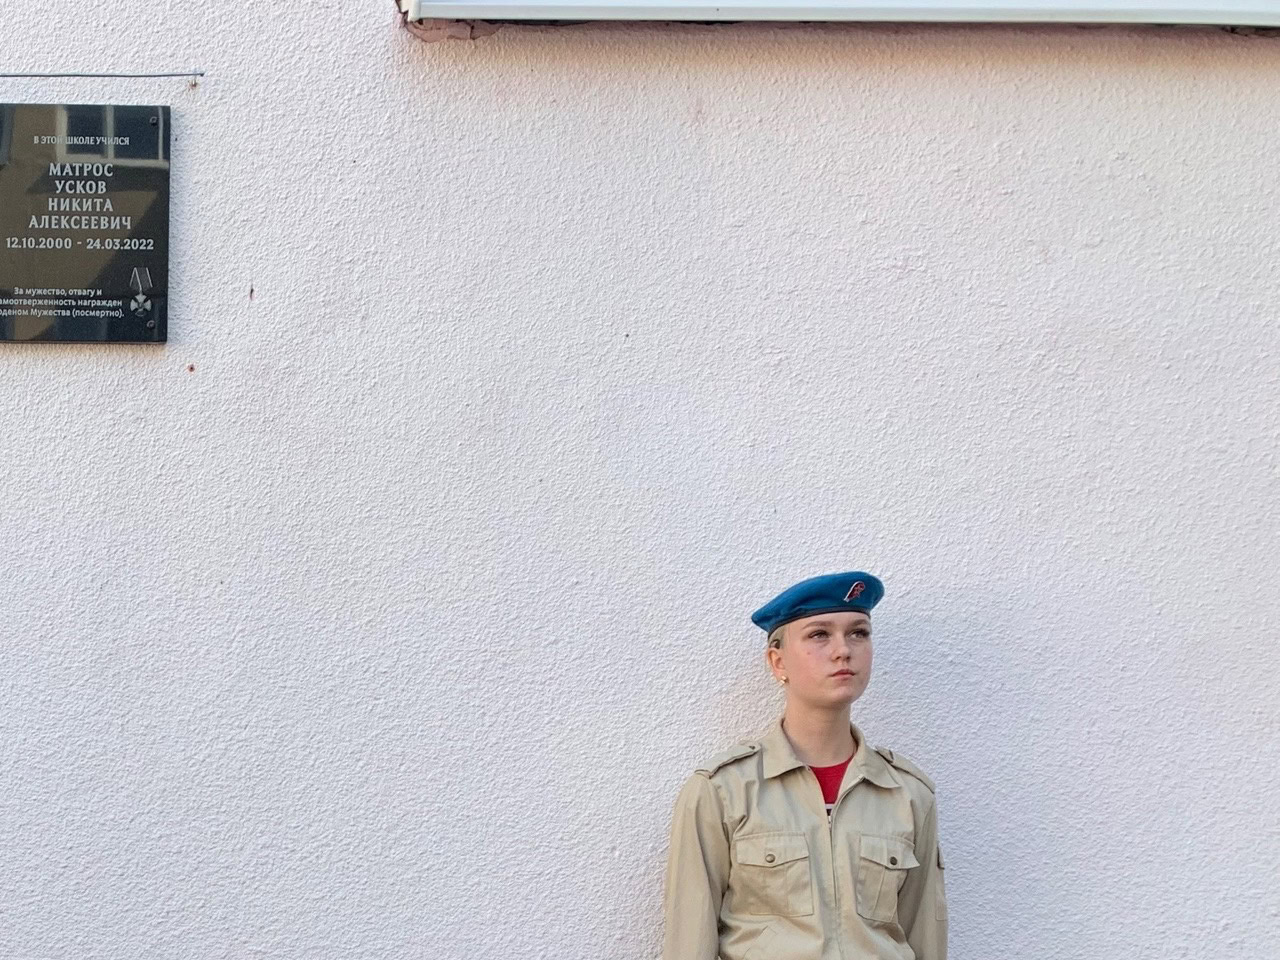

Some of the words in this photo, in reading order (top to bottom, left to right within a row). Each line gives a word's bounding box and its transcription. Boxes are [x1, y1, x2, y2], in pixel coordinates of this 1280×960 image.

[34, 136, 39, 144] В
[65, 136, 95, 144] ШКОЛЕ
[96, 137, 130, 145] УЧИЛСЯ
[49, 163, 113, 176] МАТРОС
[55, 180, 106, 194] УСКОВ
[48, 198, 113, 212] НИКИТА
[29, 216, 131, 229] АЛЕКСЕЕВИЧ
[6, 237, 72, 249] 12.10.2000
[86, 238, 154, 250] 24.03.2022
[25, 288, 67, 297] мужество,
[68, 289, 96, 297] отвагу
[30, 309, 70, 317] Мужества
[72, 309, 124, 318] (посмертно).
